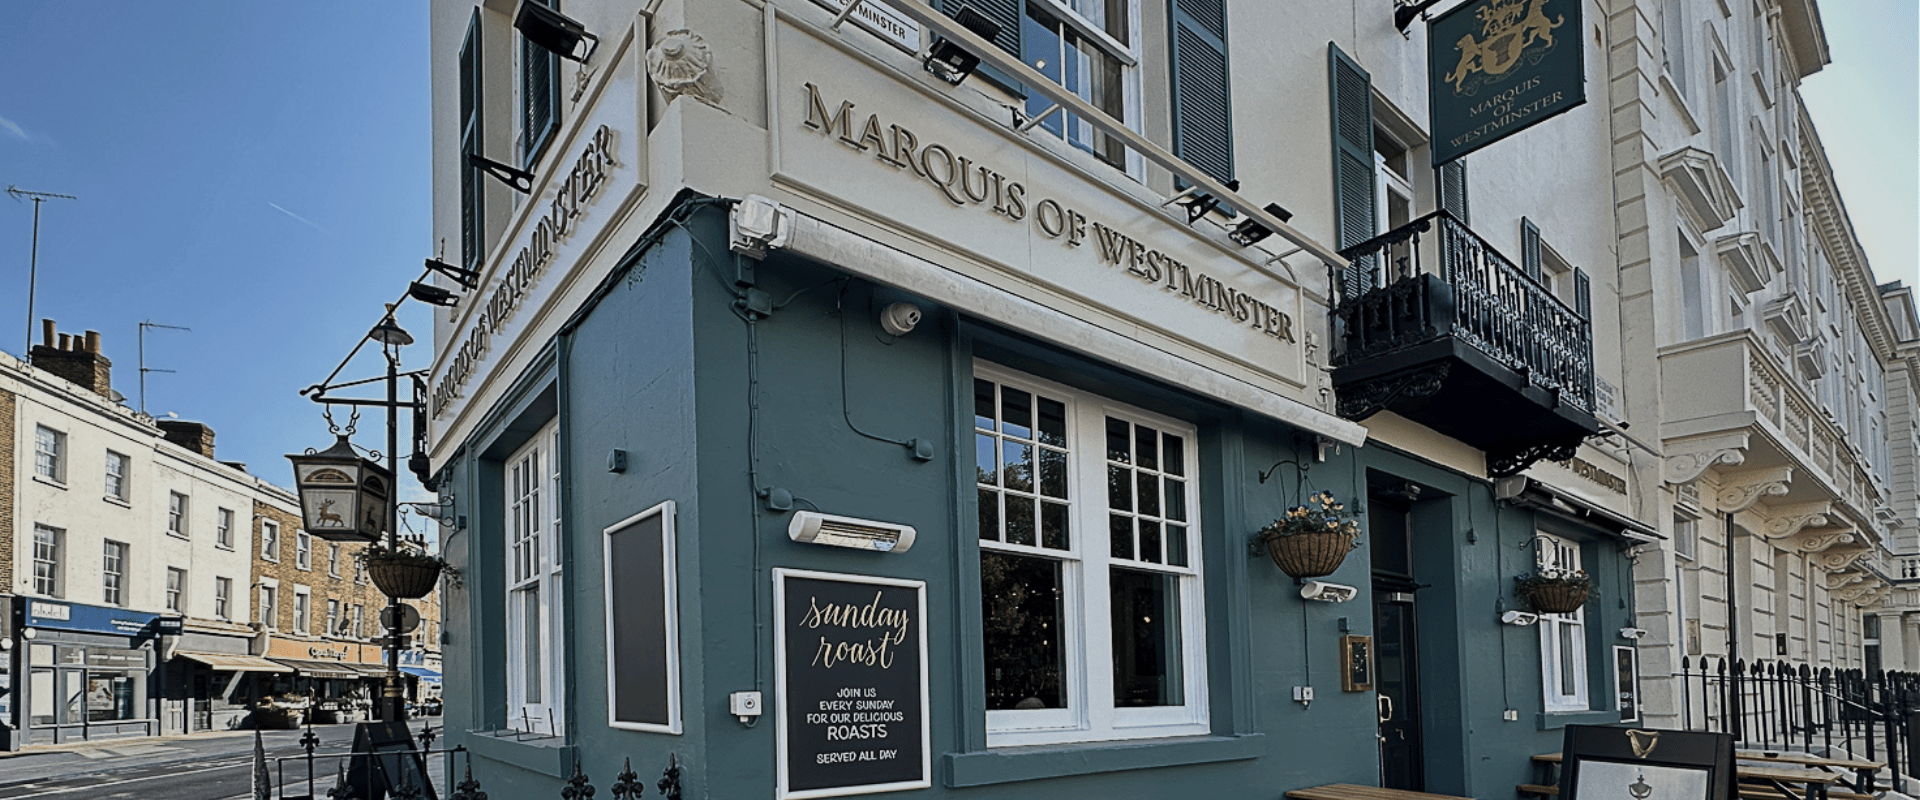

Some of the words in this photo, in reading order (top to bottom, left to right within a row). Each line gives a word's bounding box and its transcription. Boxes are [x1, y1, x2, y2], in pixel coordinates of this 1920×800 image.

[1470, 76, 1541, 118] MARQUIS
[1494, 101, 1515, 117] OF
[1450, 91, 1564, 148] WESTMINSTER
[804, 82, 1026, 220] MARQUIS
[1037, 199, 1086, 247] OF
[1092, 222, 1296, 345] WESTMINSTER
[433, 340, 470, 420] MARQUIS
[471, 314, 486, 360] OF
[487, 124, 614, 334] WESTMINSTER
[799, 591, 909, 645] sunday
[812, 631, 896, 669] roast
[819, 701, 853, 711] EVERY
[855, 700, 894, 710] SUNDAY
[837, 688, 861, 698] JOIN
[864, 687, 877, 698] US
[807, 713, 828, 724] FOR
[830, 713, 851, 723] OUR
[853, 711, 904, 723] DELICIOUS
[827, 724, 888, 740] ROASTS
[816, 752, 857, 764] SERVED
[858, 751, 877, 761] ALL
[879, 750, 897, 760] DAY
